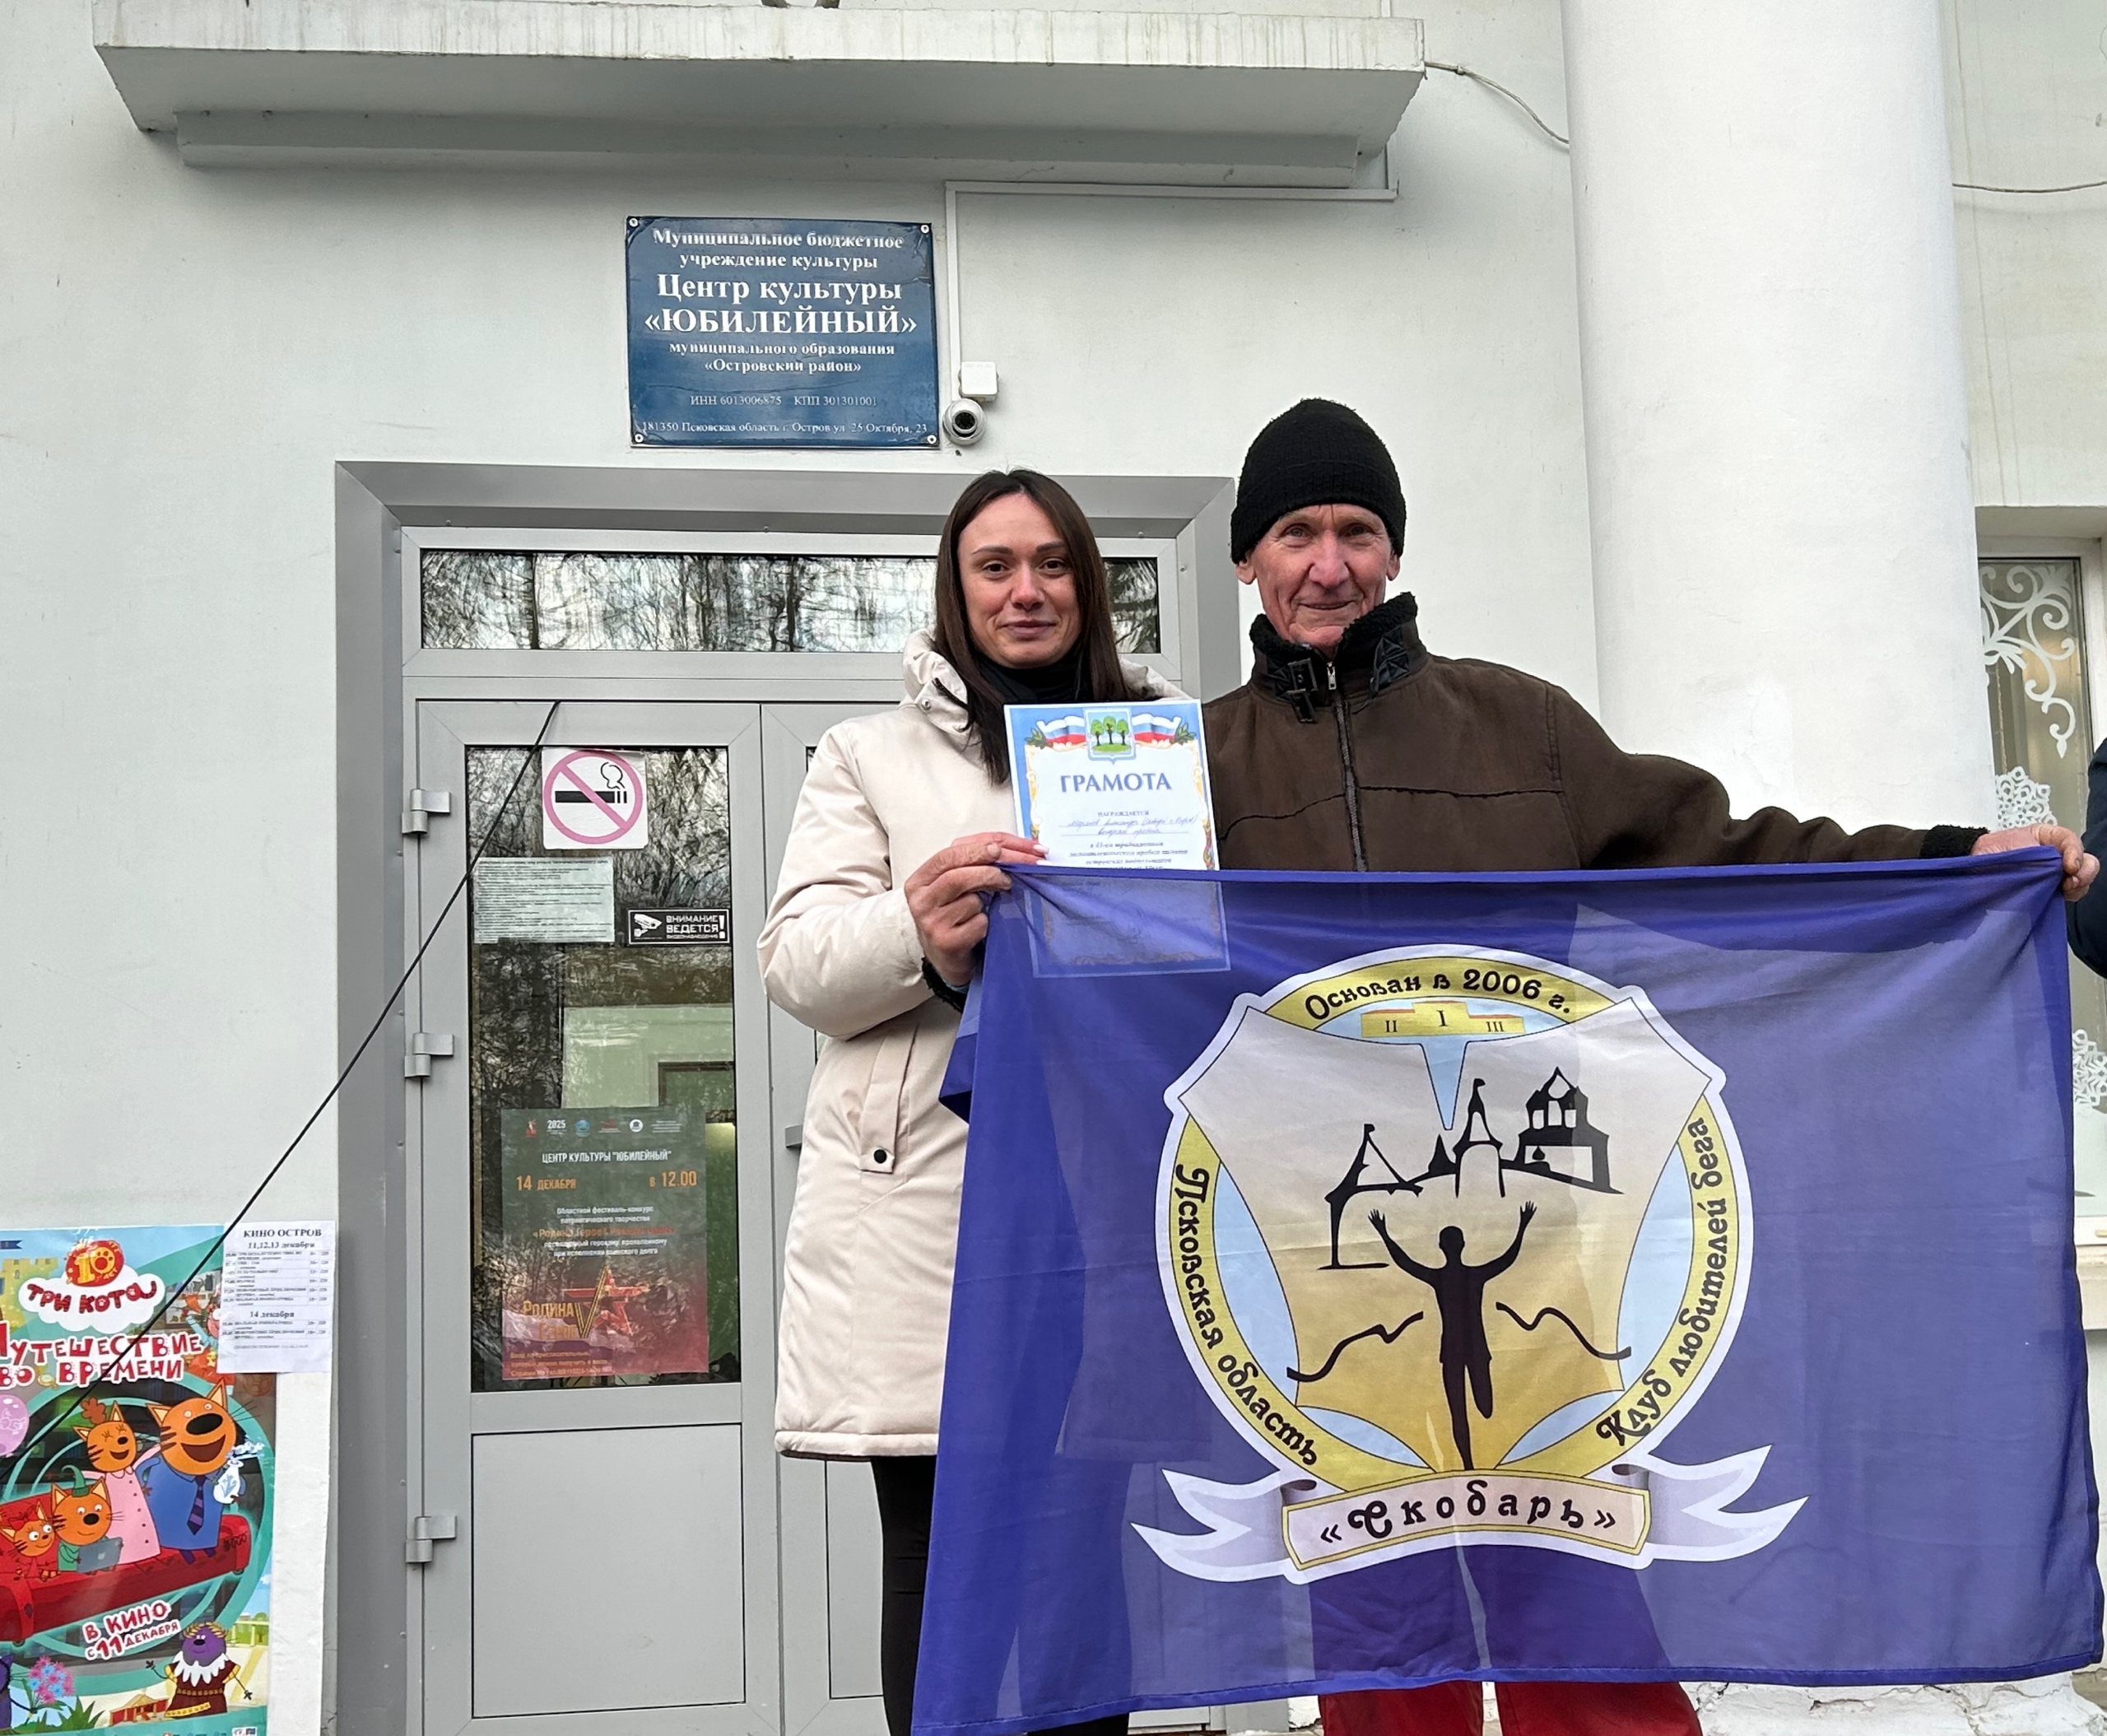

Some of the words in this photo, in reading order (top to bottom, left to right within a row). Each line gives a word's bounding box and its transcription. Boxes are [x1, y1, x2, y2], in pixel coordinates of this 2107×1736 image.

[652, 228, 802, 248] Муниципальное
[807, 231, 905, 248] бюджетное
[680, 254, 787, 270] учреждение
[792, 255, 877, 272] культуры
[658, 273, 750, 305] Центр
[760, 281, 902, 305] культуры
[644, 305, 917, 333] «ЮБИЛЕЙНЫЙ»
[669, 342, 798, 357] муниципального
[802, 343, 895, 357] образования
[705, 359, 804, 374] «Островский
[809, 360, 861, 375] район»
[691, 395, 718, 405] ИНН
[720, 395, 782, 405] 6013006875
[794, 396, 820, 406] КПП
[642, 421, 679, 432] 181350
[682, 422, 736, 432] Псковская
[739, 422, 779, 432] область
[792, 422, 830, 434] Остров
[851, 423, 863, 432] 25
[915, 424, 927, 433] 23
[1060, 773, 1172, 793] ГРАМОТА
[666, 924, 719, 933] ВЕДЕТСЯ
[1305, 974, 1421, 1020] Основан
[1432, 974, 1451, 989] в
[1463, 968, 1542, 1000] 2006
[1548, 994, 1570, 1013] г.
[1385, 1020, 1398, 1033] II
[1438, 1010, 1448, 1027] I
[1486, 1021, 1505, 1033] III
[547, 1119, 566, 1129] 2025
[542, 1152, 567, 1164] ЦЕНТР
[569, 1152, 612, 1162] КУЛЬТУРЫ
[1687, 1117, 1723, 1190] бега
[516, 1175, 533, 1191] 14
[537, 1179, 577, 1190] ДЕКАБРЯ
[661, 1171, 697, 1188] 12.00
[244, 1229, 275, 1238] КИНО
[277, 1228, 322, 1237] ОСТРОВ
[281, 1241, 315, 1250] декабря
[27, 1283, 72, 1313] ТРИ
[79, 1280, 157, 1314] КОТА
[1669, 1198, 1728, 1378] любителей
[260, 1310, 295, 1319] декабря
[1174, 1164, 1224, 1349] Псковская
[1217, 1354, 1317, 1466] область
[59, 1360, 182, 1385] ВРЕМЕНИ
[1596, 1368, 1672, 1446] Клуб
[1320, 1480, 1616, 1543] «Скобарь»
[85, 1624, 99, 1641] В
[105, 1602, 169, 1634] КИНО
[96, 1636, 123, 1657] 11
[125, 1622, 179, 1647] ДЕКАБРЯ
